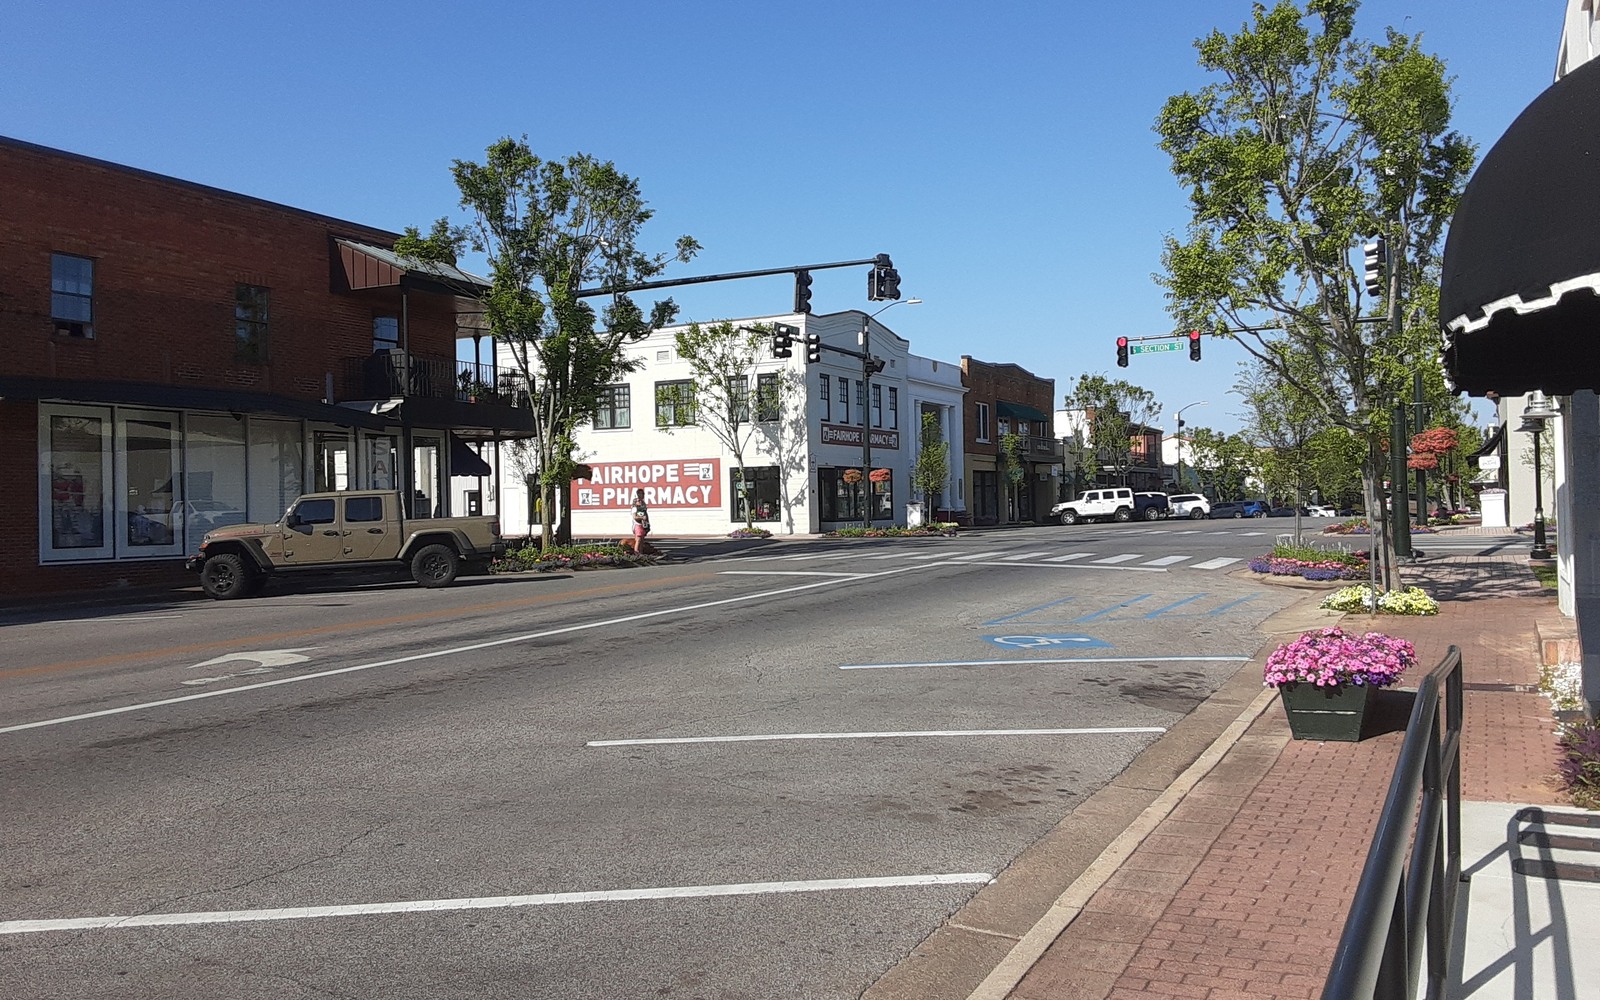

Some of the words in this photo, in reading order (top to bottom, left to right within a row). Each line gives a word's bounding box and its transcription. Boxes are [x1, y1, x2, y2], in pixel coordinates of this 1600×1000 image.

[1140, 343, 1170, 352] SECTION
[1174, 342, 1183, 350] ST
[833, 430, 860, 442] FAIRHOPE
